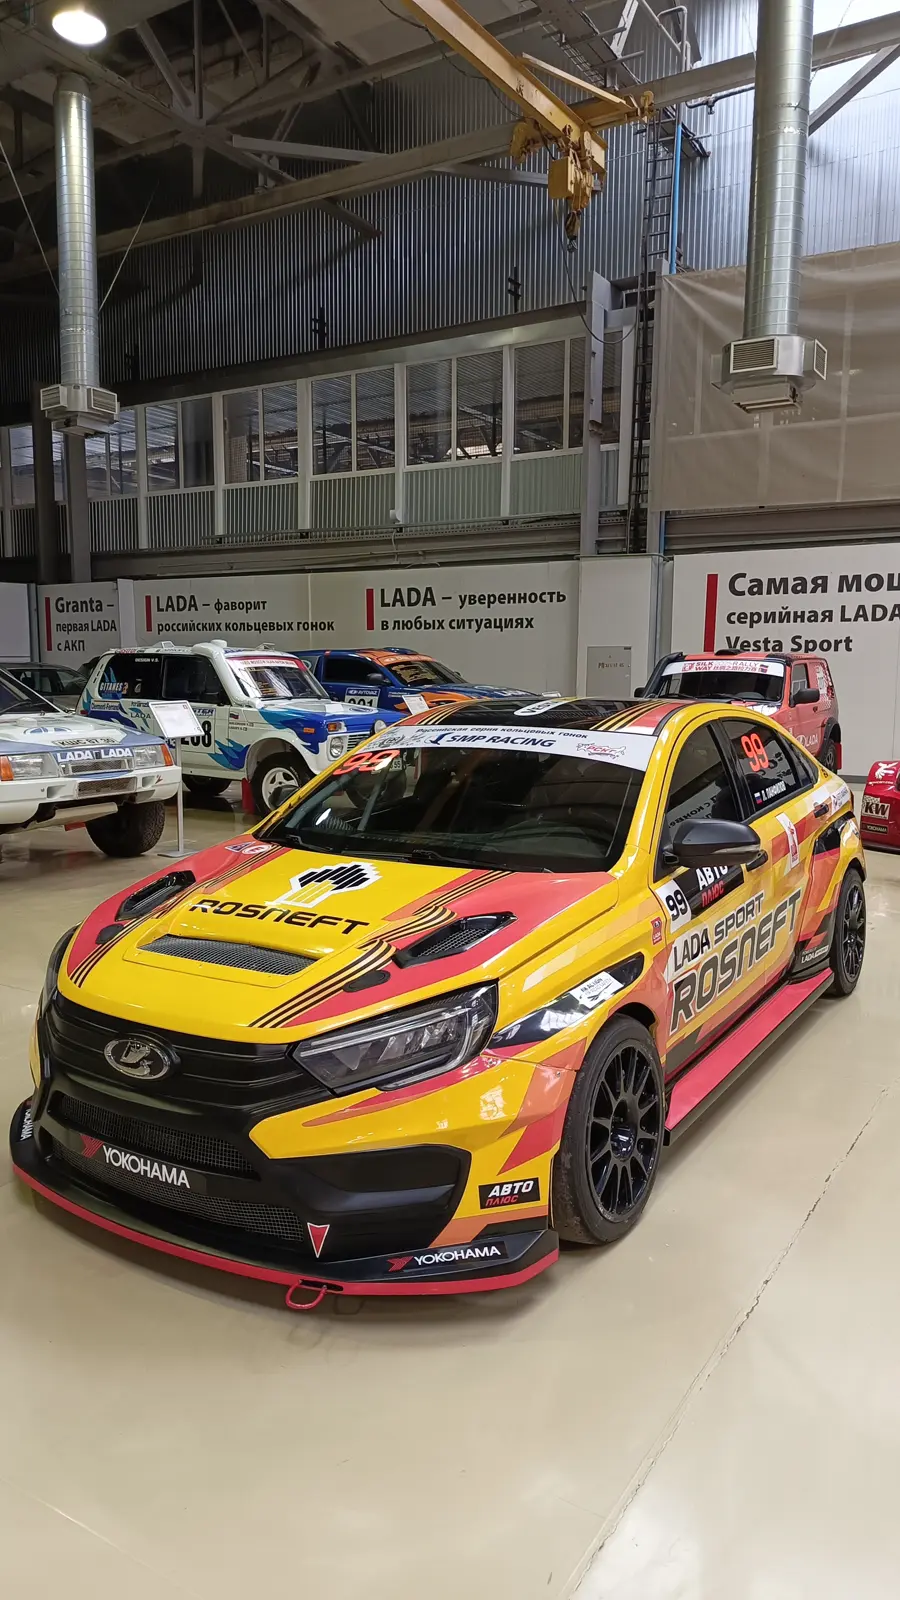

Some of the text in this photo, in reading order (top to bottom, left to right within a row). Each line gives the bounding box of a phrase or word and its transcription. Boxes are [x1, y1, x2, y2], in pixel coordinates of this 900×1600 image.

[728, 572, 829, 597] Самая
[55, 596, 103, 613] Granta
[156, 594, 199, 612] LADA
[213, 598, 267, 614] фаворит
[380, 586, 437, 608] LADA
[458, 590, 567, 609] уверенность
[381, 615, 534, 633] в любых ситуациях
[726, 603, 900, 629] серийная LADA
[56, 619, 117, 635] первая LADA
[157, 620, 335, 635] российских кольцевых гонок
[57, 639, 85, 651] с АКП
[725, 635, 853, 653] Vesta Sport
[445, 735, 557, 748] SMP RACING
[501, 727, 555, 735] кольцевых
[558, 731, 589, 739] гонок
[56, 748, 132, 763] LADA LADA
[740, 732, 769, 772] 99
[864, 801, 889, 816] KW
[665, 889, 688, 921] 99
[188, 898, 370, 935] ROSNEFT
[673, 891, 765, 973] LADA SPORT
[670, 887, 801, 1034] ROSNEFT
[102, 1144, 190, 1189] YOKOHAMA
[488, 1180, 534, 1198] АВТО
[485, 1195, 519, 1207] ПЛЮС
[413, 1245, 501, 1266] YOKOHAMA
